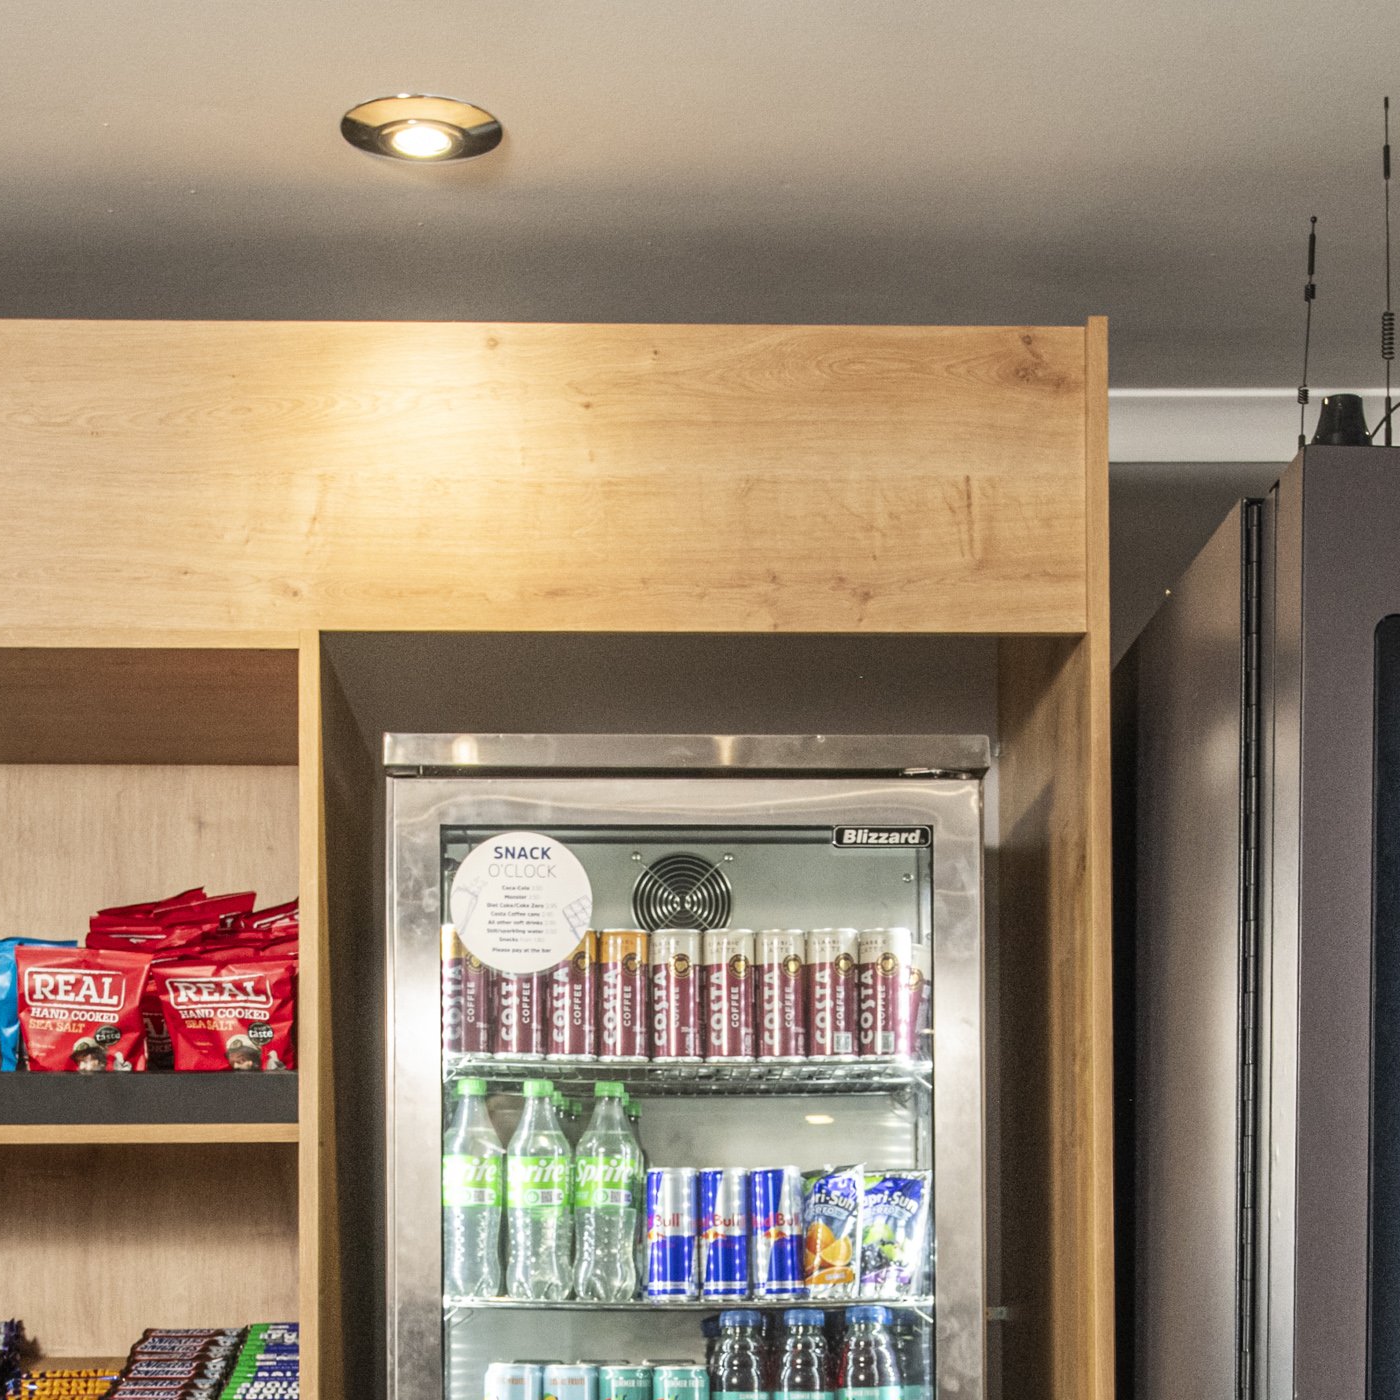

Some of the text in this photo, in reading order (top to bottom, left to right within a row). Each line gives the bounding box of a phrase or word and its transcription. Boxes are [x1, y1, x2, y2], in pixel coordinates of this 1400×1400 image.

[843, 829, 921, 844] Blizzard
[494, 846, 552, 860] SNACK
[488, 864, 557, 878] O'CLOCK
[33, 974, 119, 1005] REAL
[177, 981, 267, 1002] REAL
[466, 981, 476, 1023] COFFEE
[31, 1007, 119, 1023] HAND COOKED
[180, 1008, 269, 1021] HAND COOKED
[553, 966, 570, 1043] COSTA
[573, 983, 582, 1026] COFFEE
[603, 968, 618, 1045] COSTA
[623, 985, 632, 1027] COFFEE
[653, 969, 668, 1046] COSTA
[731, 986, 740, 1028] COFFEE
[860, 968, 874, 1045] COSTA
[28, 1018, 85, 1033] SEA SALT
[577, 1159, 633, 1187] Sprite
[776, 1212, 799, 1227] Bull
